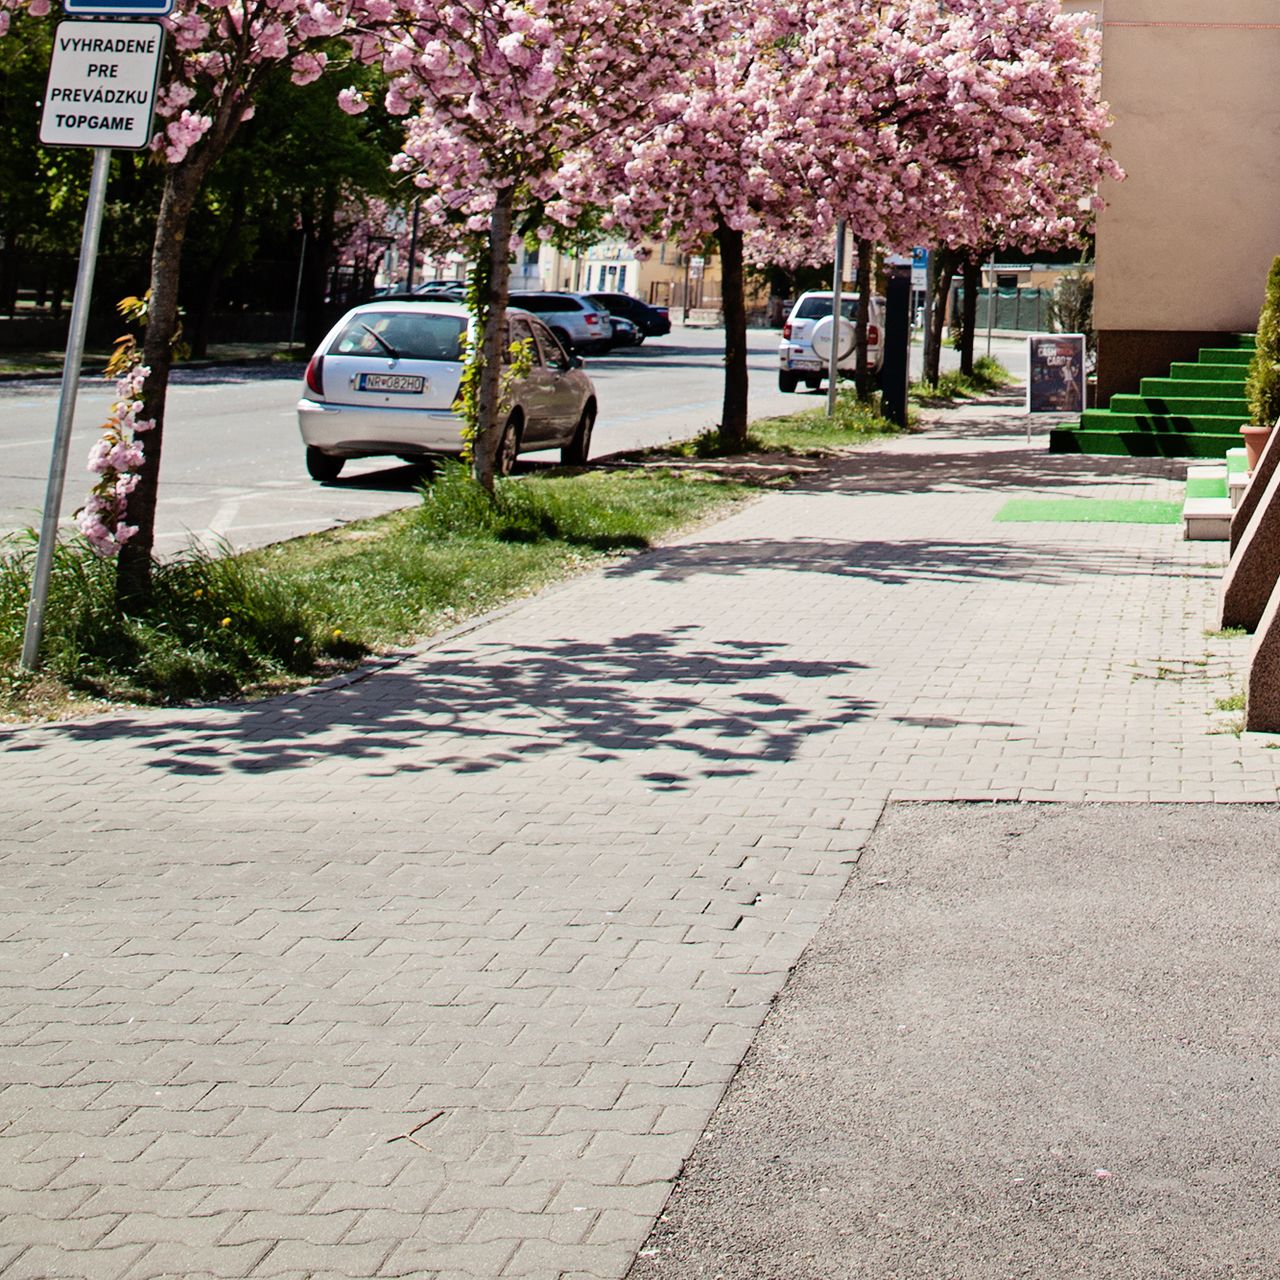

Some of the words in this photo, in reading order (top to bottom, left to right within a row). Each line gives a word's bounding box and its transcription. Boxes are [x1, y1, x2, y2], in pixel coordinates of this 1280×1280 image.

[60, 35, 156, 54] VYHRADENÉ
[87, 63, 119, 78] PRE
[50, 84, 148, 105] PREVÁDZKU
[55, 114, 135, 131] TOPGAME
